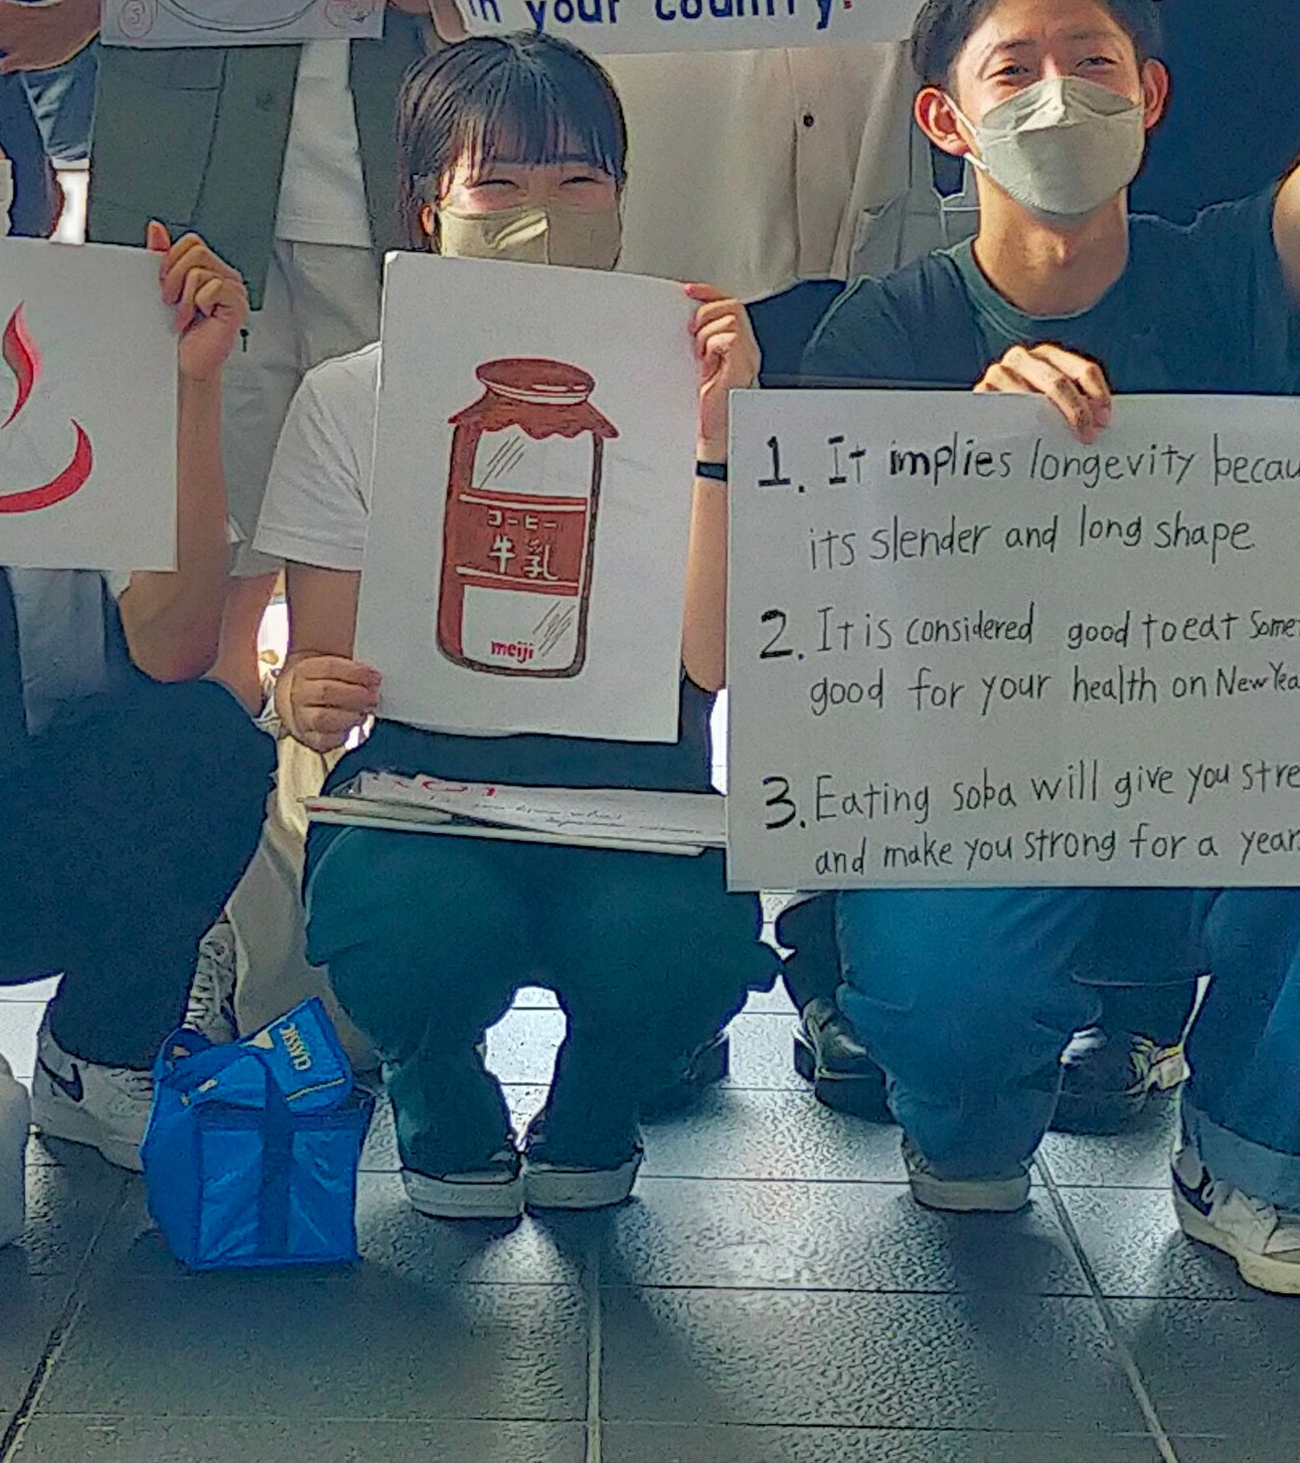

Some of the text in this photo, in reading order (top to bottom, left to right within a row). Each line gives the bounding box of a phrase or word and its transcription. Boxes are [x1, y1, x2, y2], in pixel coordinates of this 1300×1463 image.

[758, 435, 806, 493] 1.
[828, 435, 867, 485] It
[889, 431, 1012, 487] implies
[1031, 437, 1195, 489] longevity
[487, 510, 558, 531] コーヒー
[809, 527, 857, 571] its
[870, 514, 993, 563] slender
[1005, 514, 1059, 553] and
[1079, 503, 1142, 547] long
[488, 534, 558, 582] 牛乳
[491, 640, 536, 664] meiji
[759, 609, 804, 660] 2.
[817, 607, 853, 651] It
[865, 613, 892, 649] is
[907, 601, 1035, 645] considered
[1067, 610, 1130, 650] good
[811, 668, 884, 716] good
[908, 666, 965, 711] for
[981, 673, 1051, 716] your
[1073, 665, 1156, 704] health
[1172, 674, 1207, 698] on
[815, 775, 929, 824] Eating
[953, 767, 1017, 811] soba
[1031, 760, 1097, 800] will
[1115, 765, 1174, 808] give
[1188, 763, 1229, 804] you
[815, 836, 867, 875] and
[884, 831, 952, 867] make
[965, 837, 1012, 871] you
[1025, 827, 1115, 861] strong
[1130, 823, 1186, 859] for
[1199, 837, 1219, 857] a
